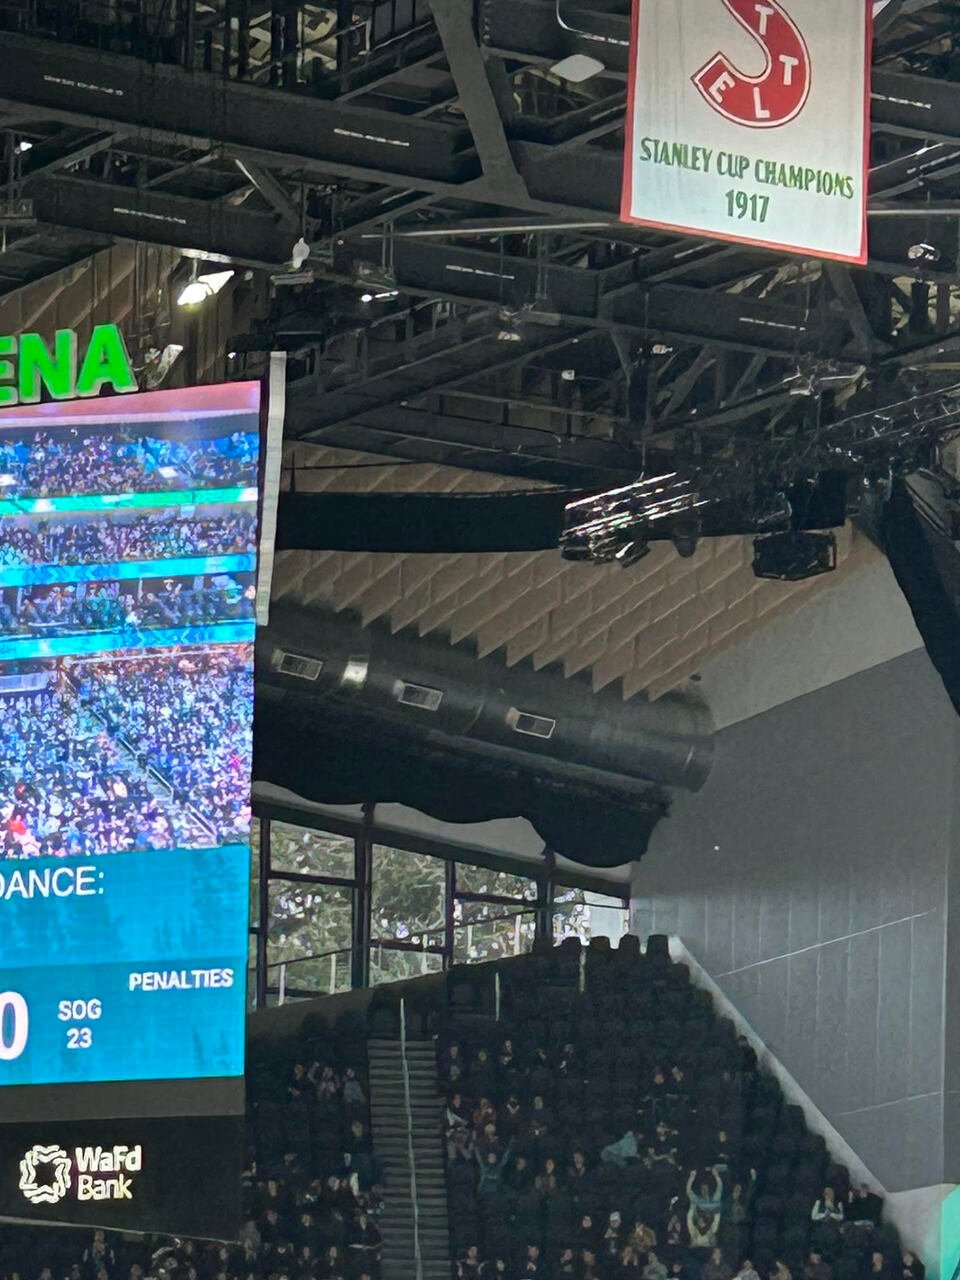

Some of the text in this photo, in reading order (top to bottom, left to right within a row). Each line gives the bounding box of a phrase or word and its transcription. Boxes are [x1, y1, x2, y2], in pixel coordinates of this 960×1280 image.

[640, 137, 855, 200] STANLEY CUP CHAMPIONS
[725, 189, 770, 223] 1917
[129, 968, 234, 992] PENALTIES
[58, 999, 102, 1021] SOG
[66, 1028, 93, 1050] 23
[75, 1144, 142, 1172] WaFd
[77, 1173, 133, 1201] Bank
